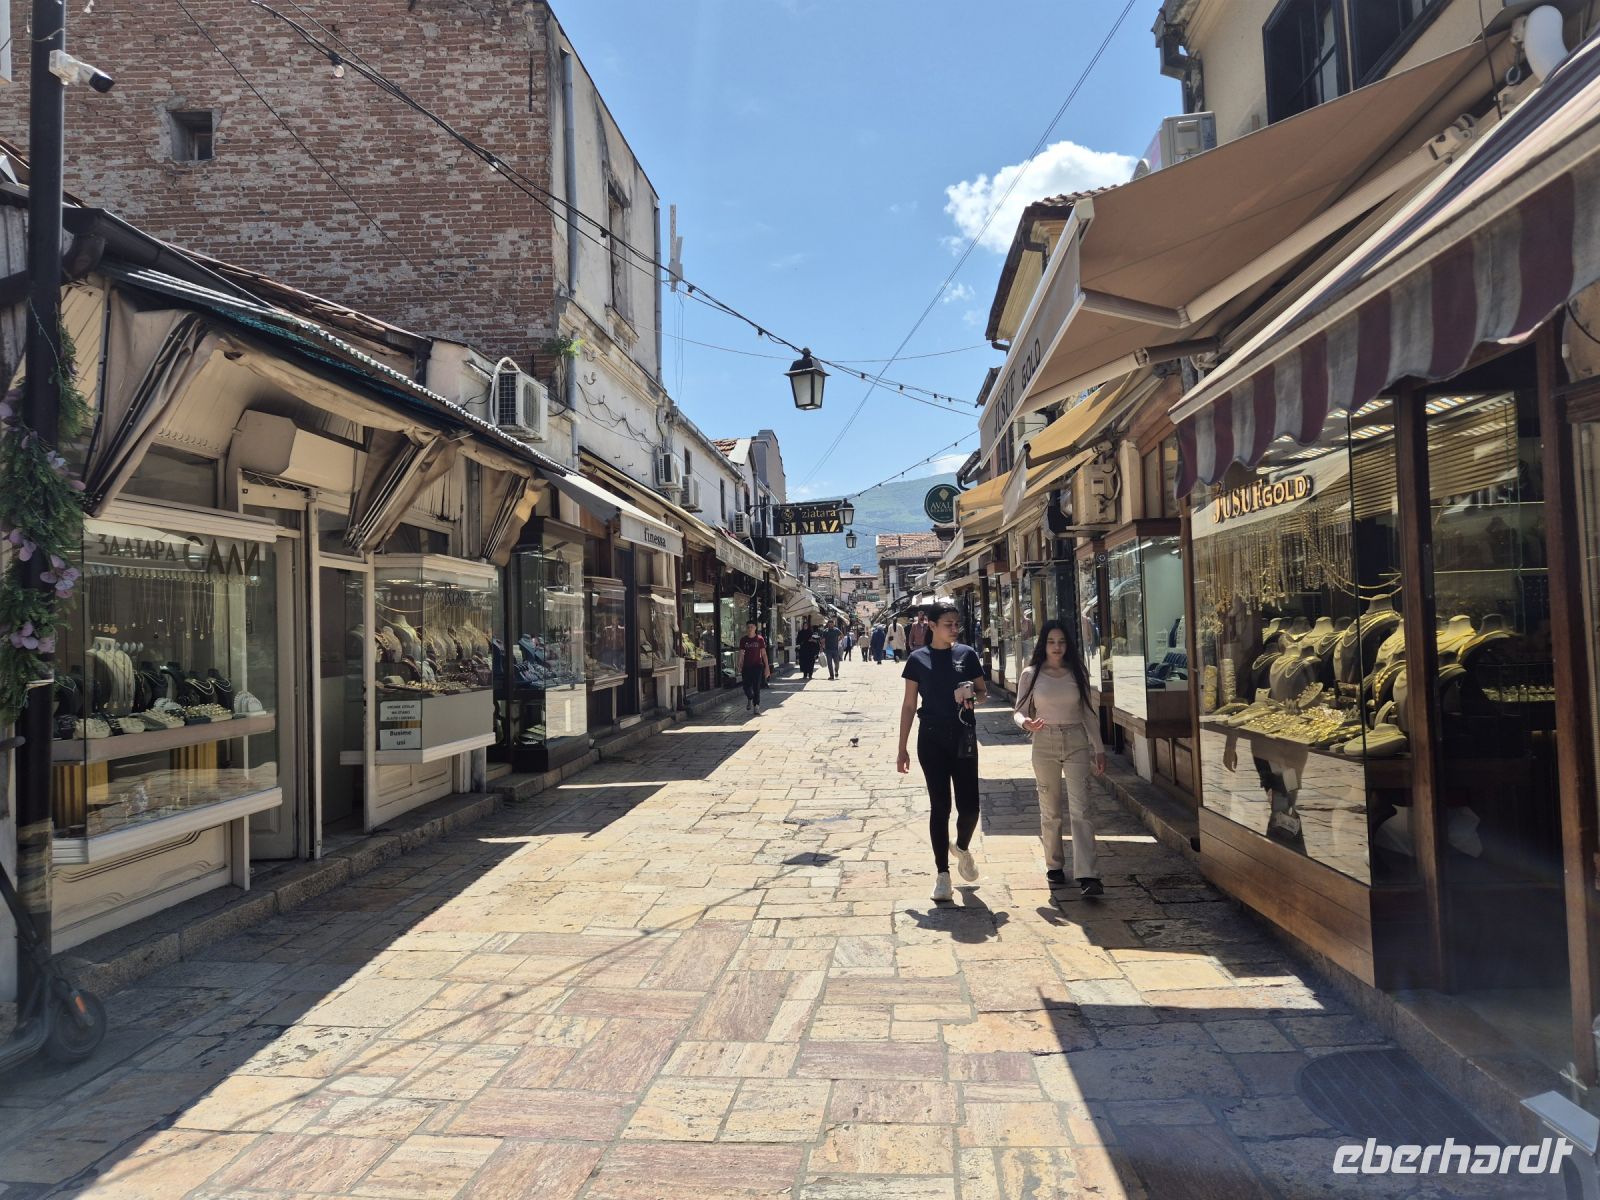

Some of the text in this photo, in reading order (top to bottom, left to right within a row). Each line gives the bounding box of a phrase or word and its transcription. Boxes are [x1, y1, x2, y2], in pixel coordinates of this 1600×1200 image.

[1021, 337, 1041, 391] GOLD
[801, 508, 837, 519] zlatara
[779, 519, 840, 536] ELMAZ
